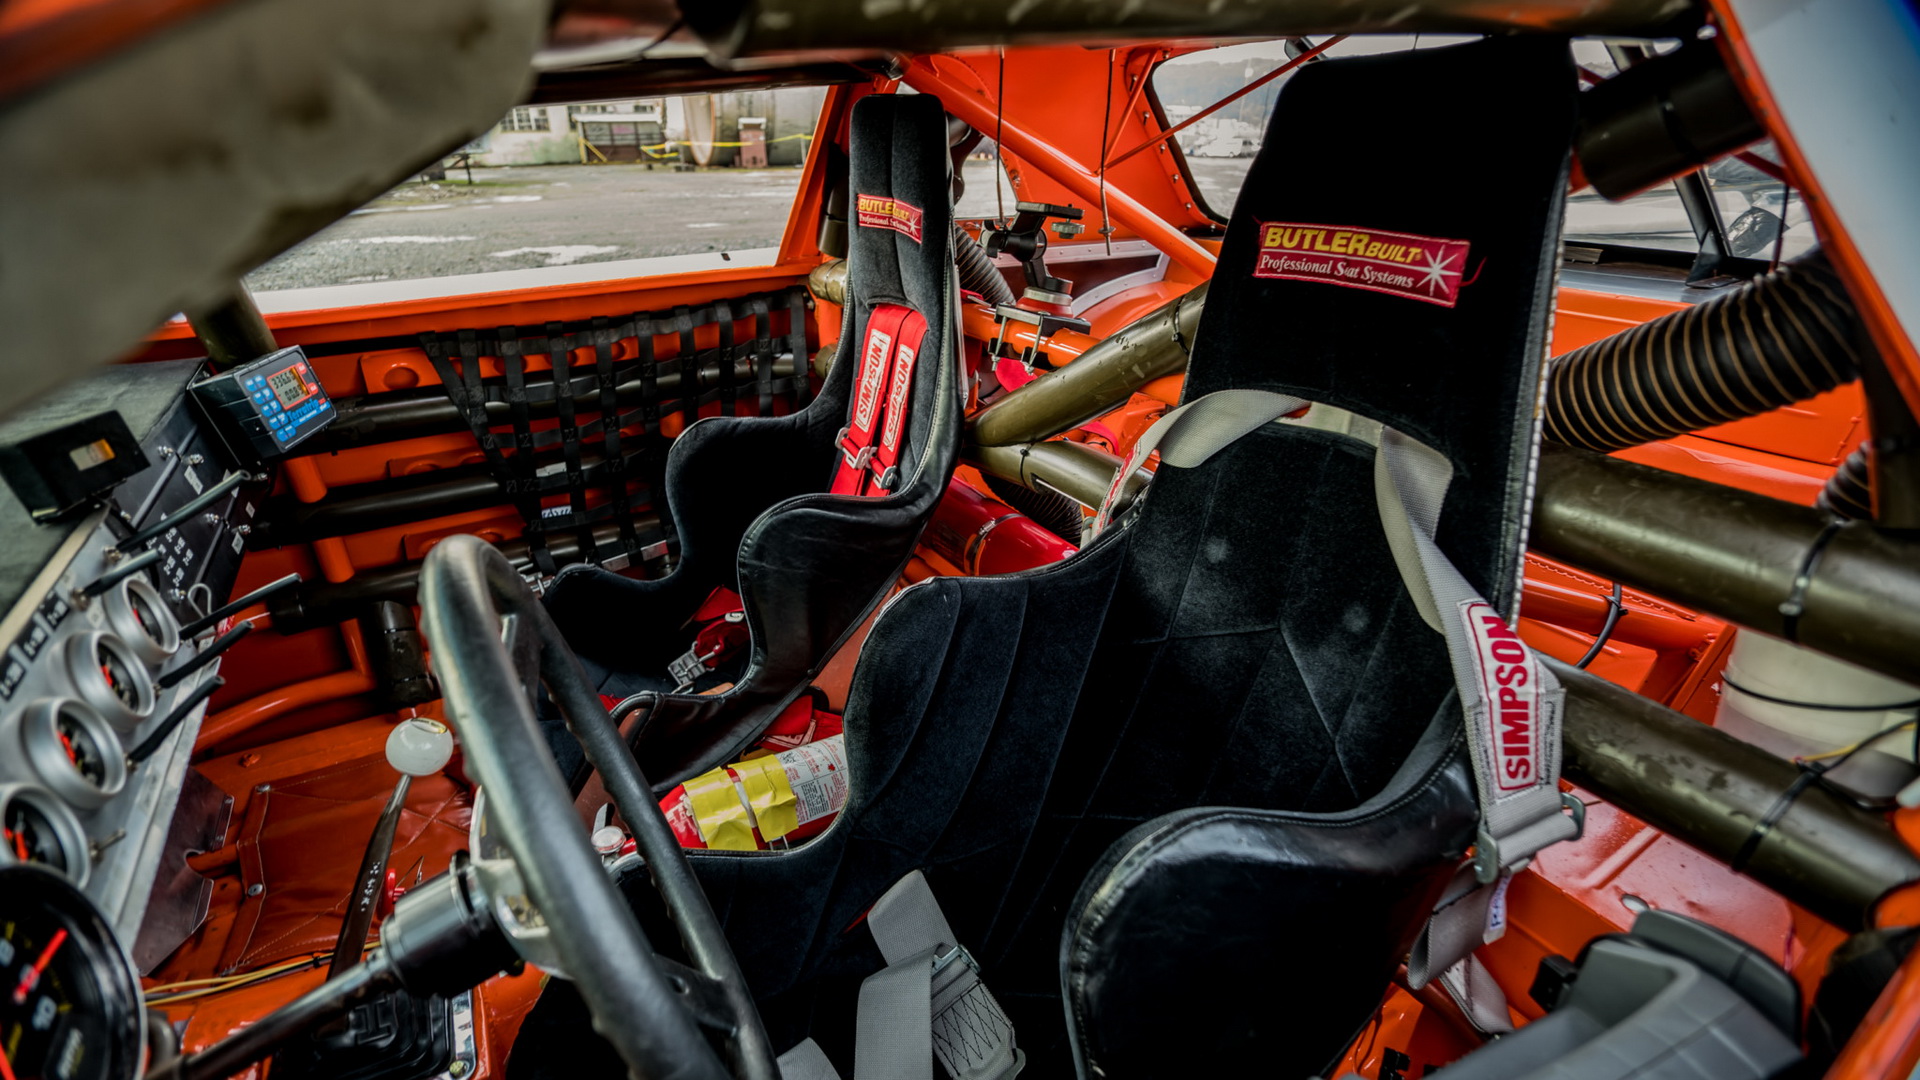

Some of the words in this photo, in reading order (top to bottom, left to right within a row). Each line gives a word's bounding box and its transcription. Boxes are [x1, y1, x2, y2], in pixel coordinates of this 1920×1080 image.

[1260, 255, 1333, 275] Professional
[1360, 265, 1414, 288] Systems
[859, 343, 883, 418] SIMPSON
[887, 358, 909, 434] SIMPSON
[1481, 616, 1531, 780] SIMPSON
